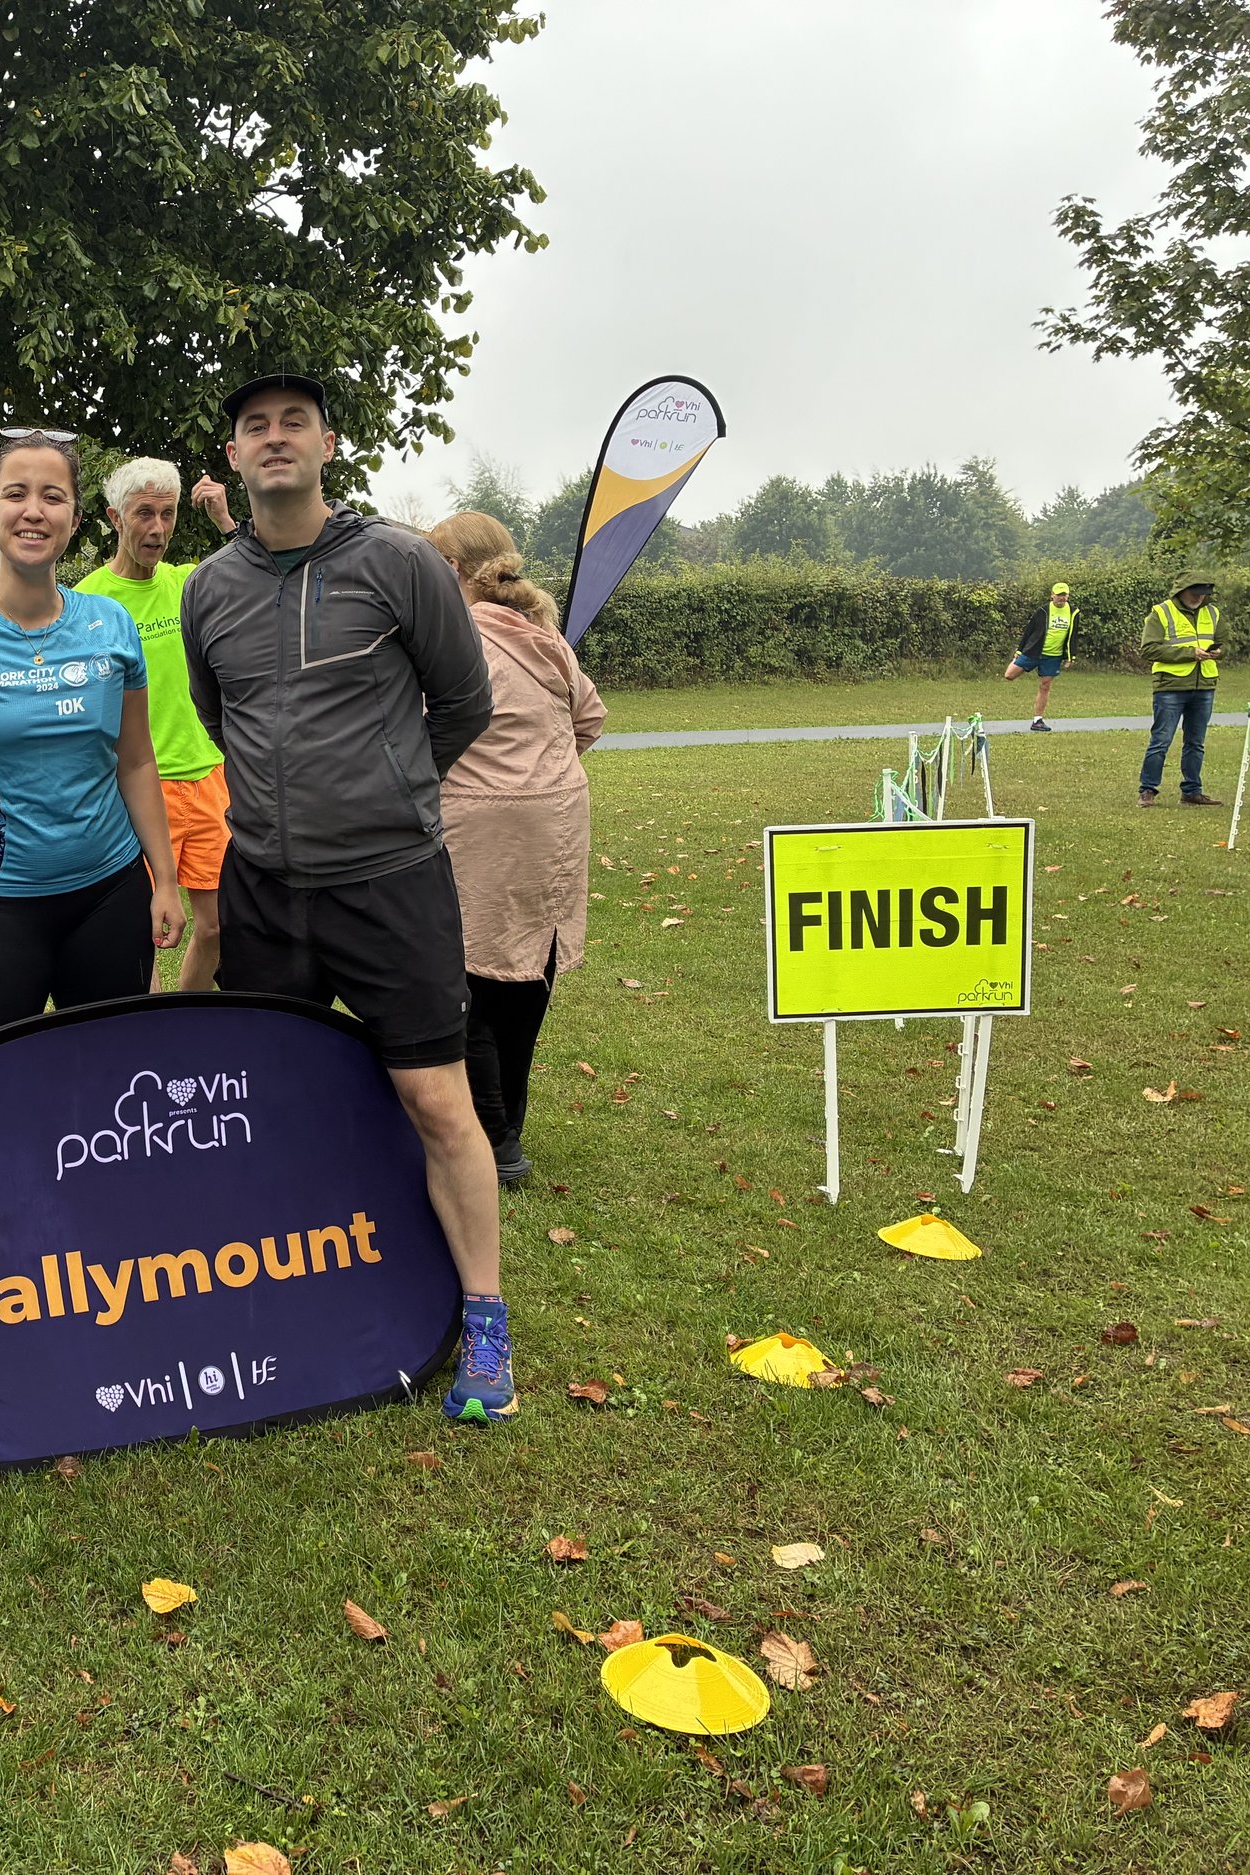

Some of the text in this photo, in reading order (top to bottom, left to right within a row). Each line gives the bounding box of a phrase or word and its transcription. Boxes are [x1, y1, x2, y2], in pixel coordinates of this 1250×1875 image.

[636, 403, 697, 424] parkrun
[685, 401, 701, 411] Vhi
[28, 667, 55, 680] CITY
[36, 682, 59, 692] 2024
[55, 697, 85, 716] 10K
[788, 886, 1007, 951] FINISH
[998, 981, 1013, 989] Vhi
[957, 986, 1013, 1005] parkrun
[198, 1070, 248, 1103] Vhi
[168, 1107, 198, 1118] presents
[56, 1099, 251, 1181] parkrun
[124, 1375, 175, 1408] Vhi
[204, 1371, 219, 1386] hi
